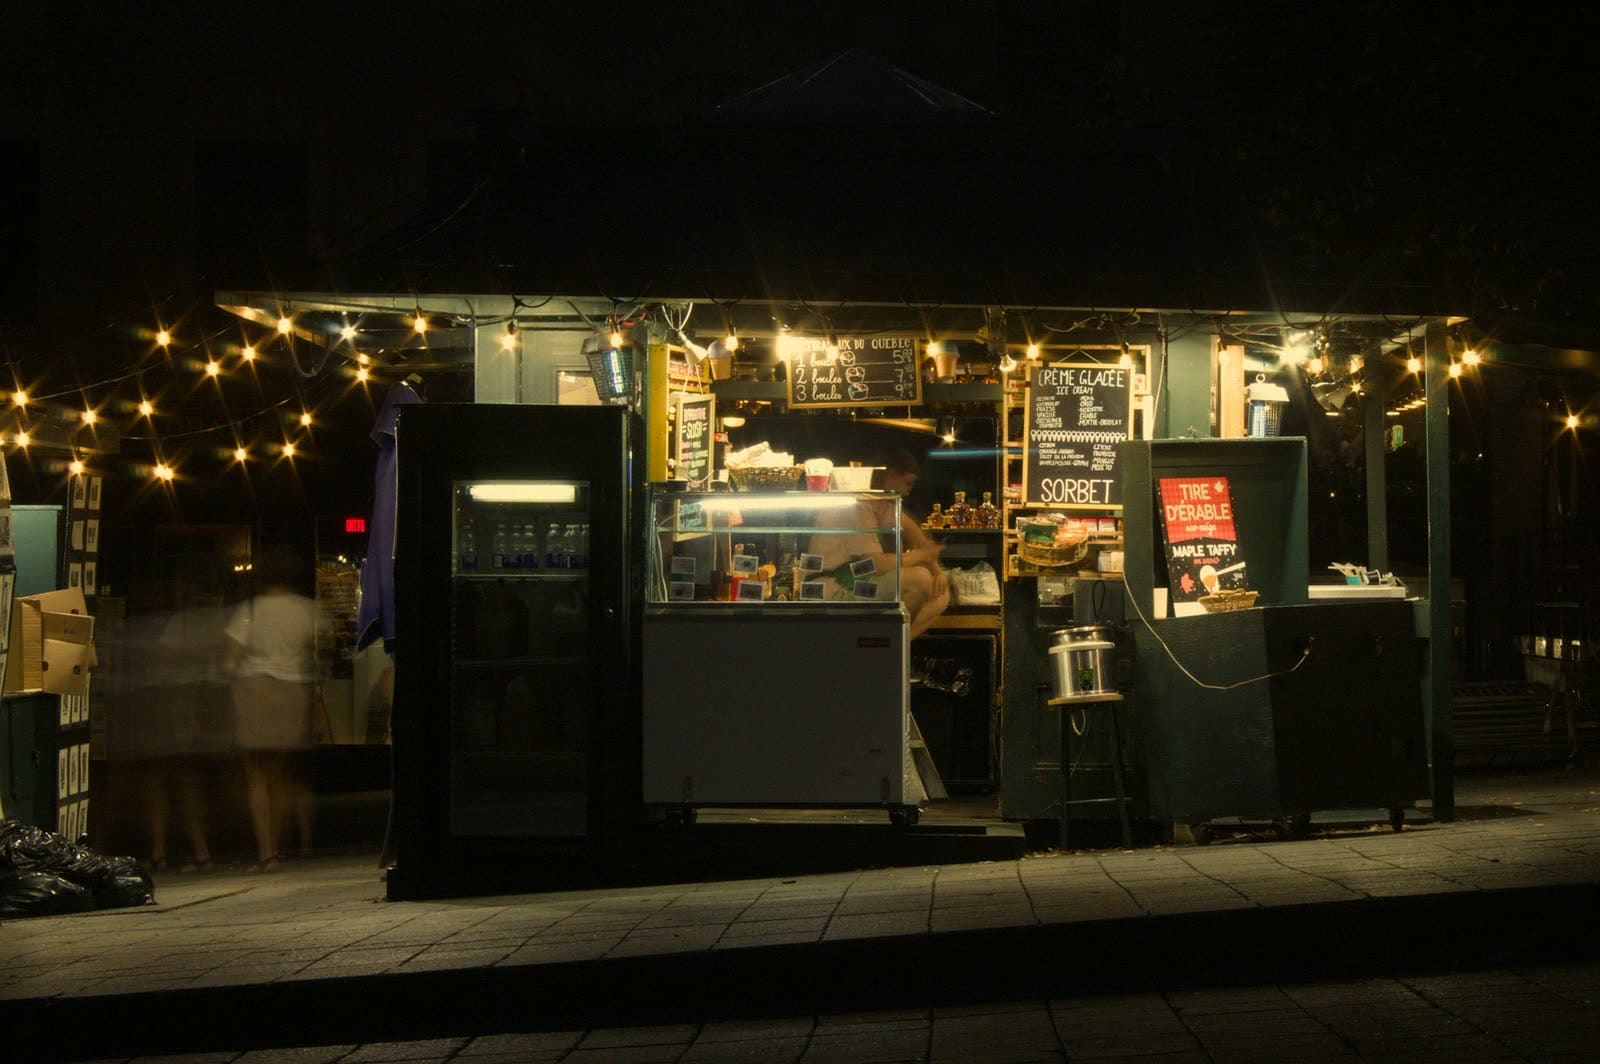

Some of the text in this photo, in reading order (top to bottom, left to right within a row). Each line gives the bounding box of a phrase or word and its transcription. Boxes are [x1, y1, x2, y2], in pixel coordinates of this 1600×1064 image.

[796, 367, 807, 385] 2
[1038, 368, 1125, 388] CRÈME GLACÉE
[796, 384, 808, 402] 3
[1056, 385, 1094, 395] ICE CREAM
[1041, 478, 1114, 504] SORBET
[1178, 483, 1212, 501] TIRE
[1166, 500, 1232, 522] D'ÉRABLE
[1172, 543, 1238, 558] MAPLE TAFFY
